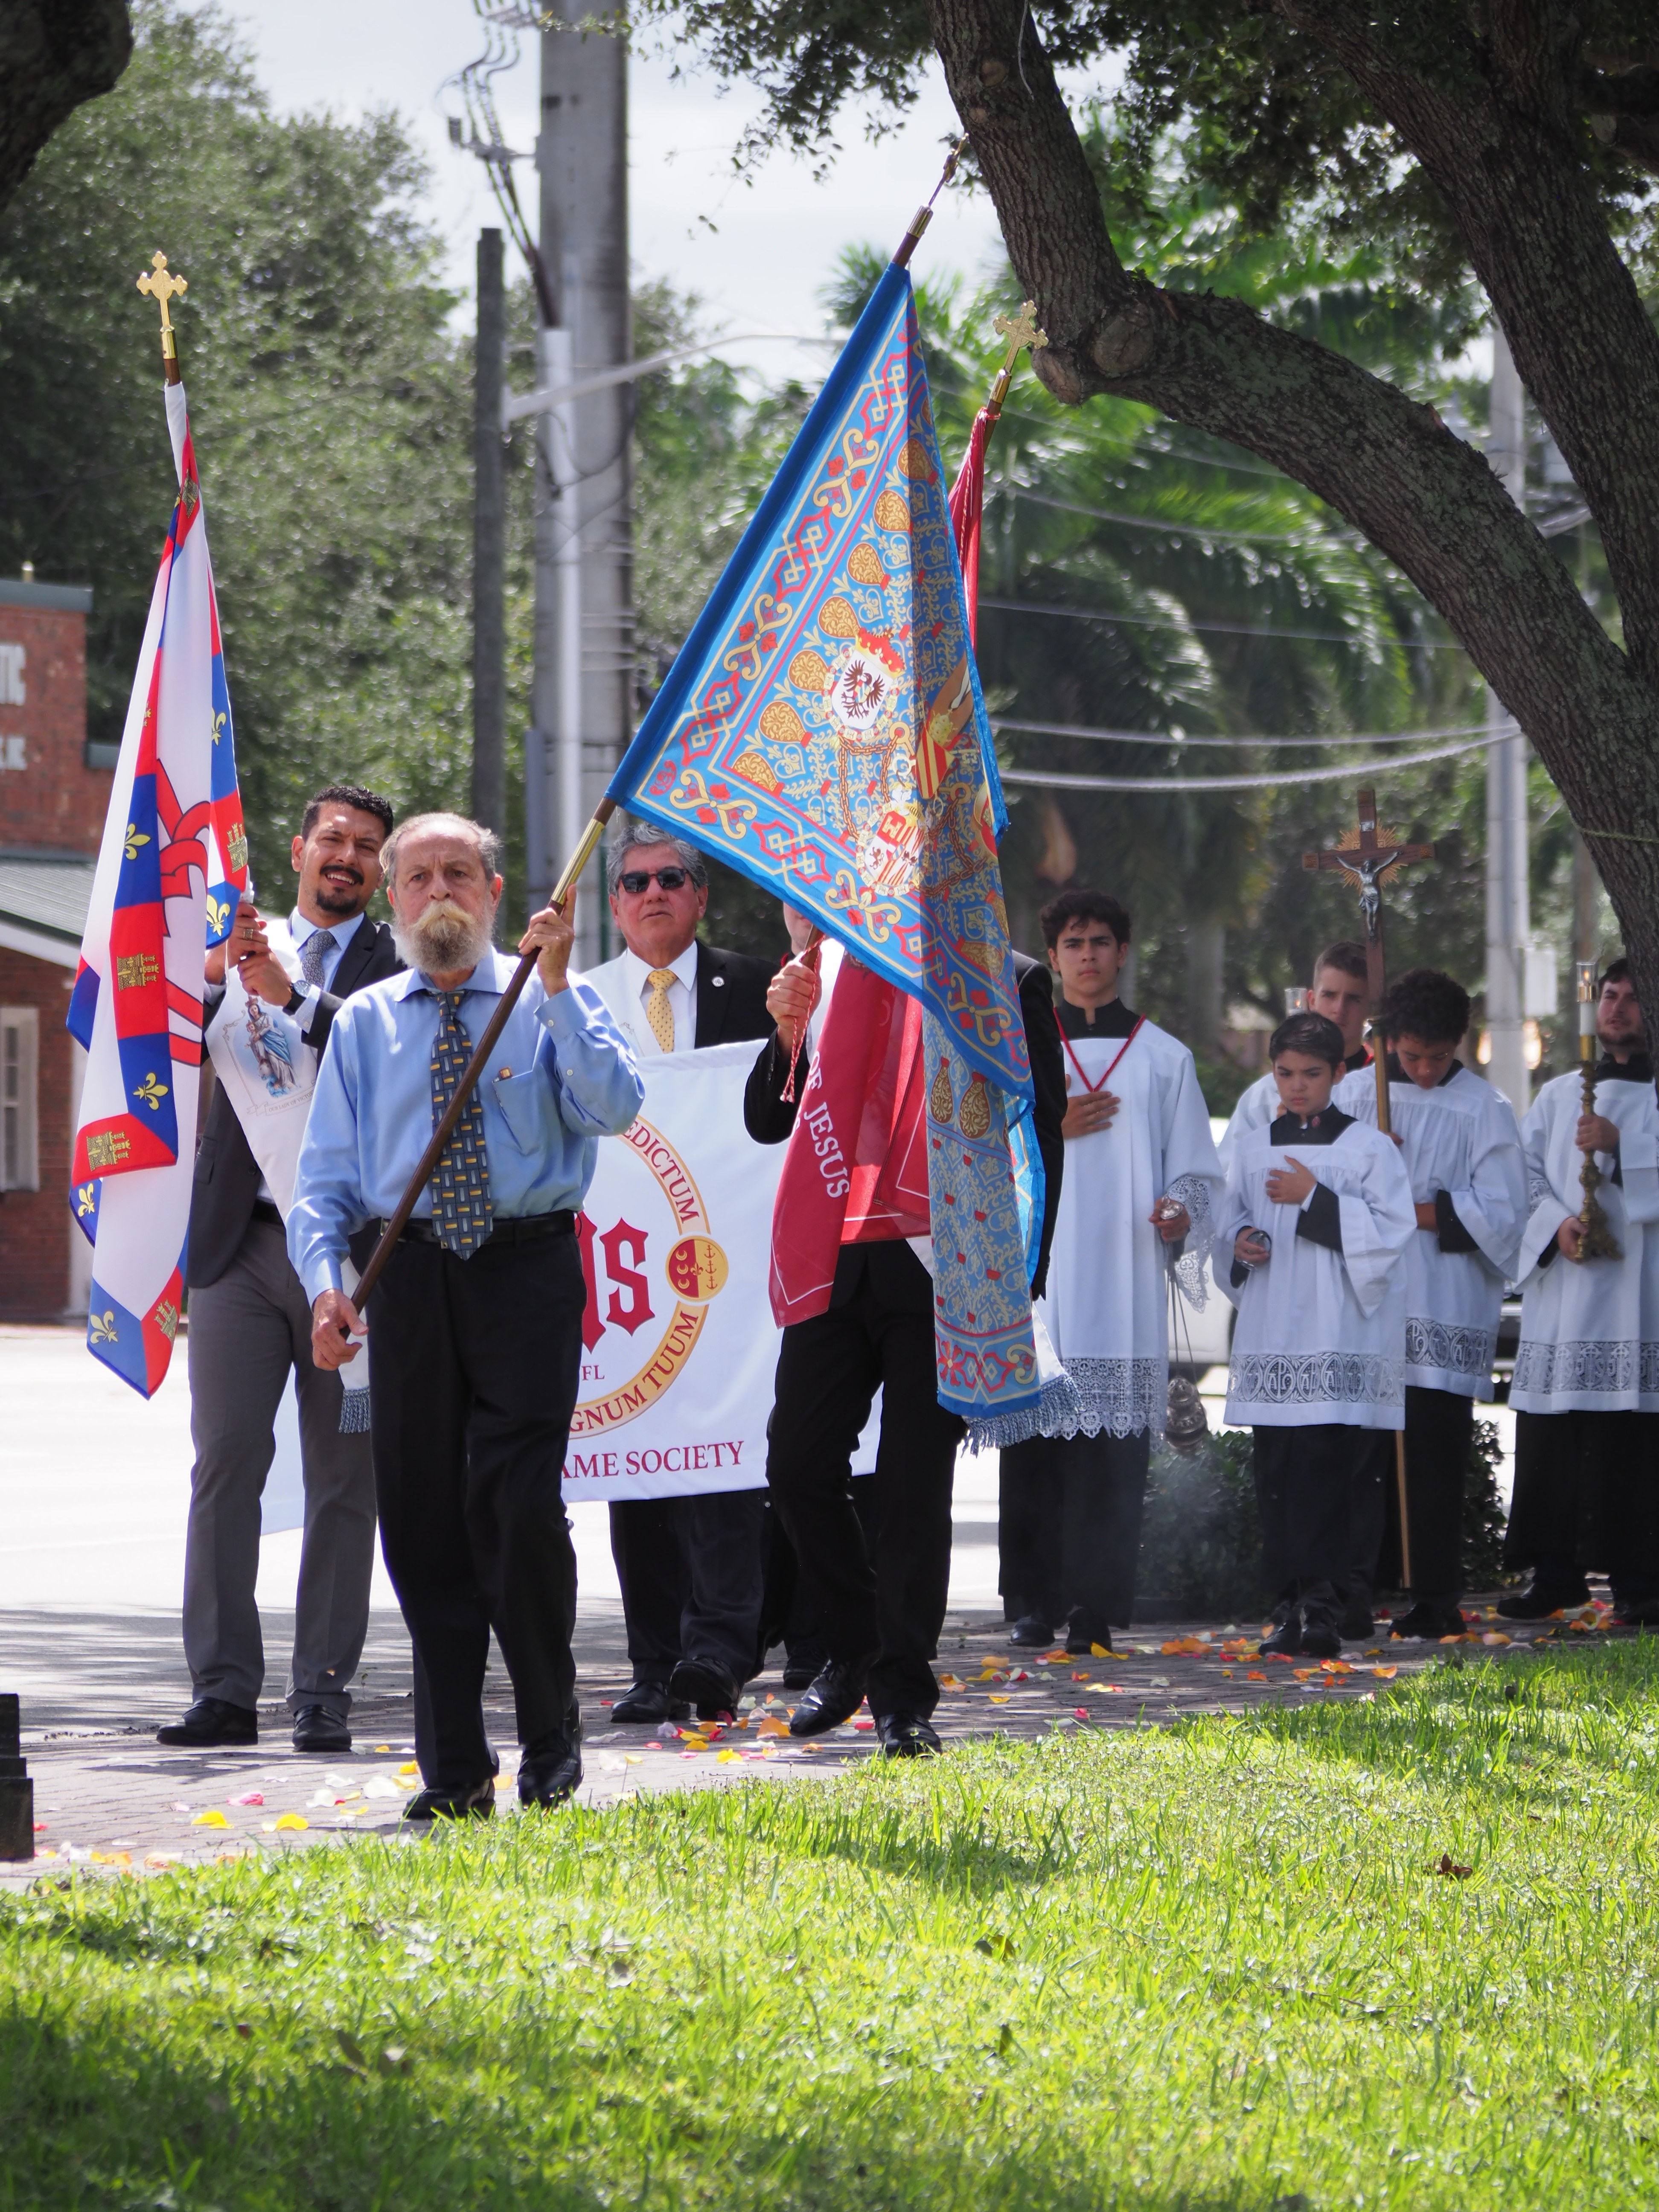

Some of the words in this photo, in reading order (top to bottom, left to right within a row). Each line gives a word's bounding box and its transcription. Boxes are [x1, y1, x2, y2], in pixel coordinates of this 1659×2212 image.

[808, 1051, 823, 1091] OF
[804, 1102, 850, 1198] JESUS
[642, 1310, 699, 1390] TUUM
[626, 1441, 744, 1475] SOCIETY
